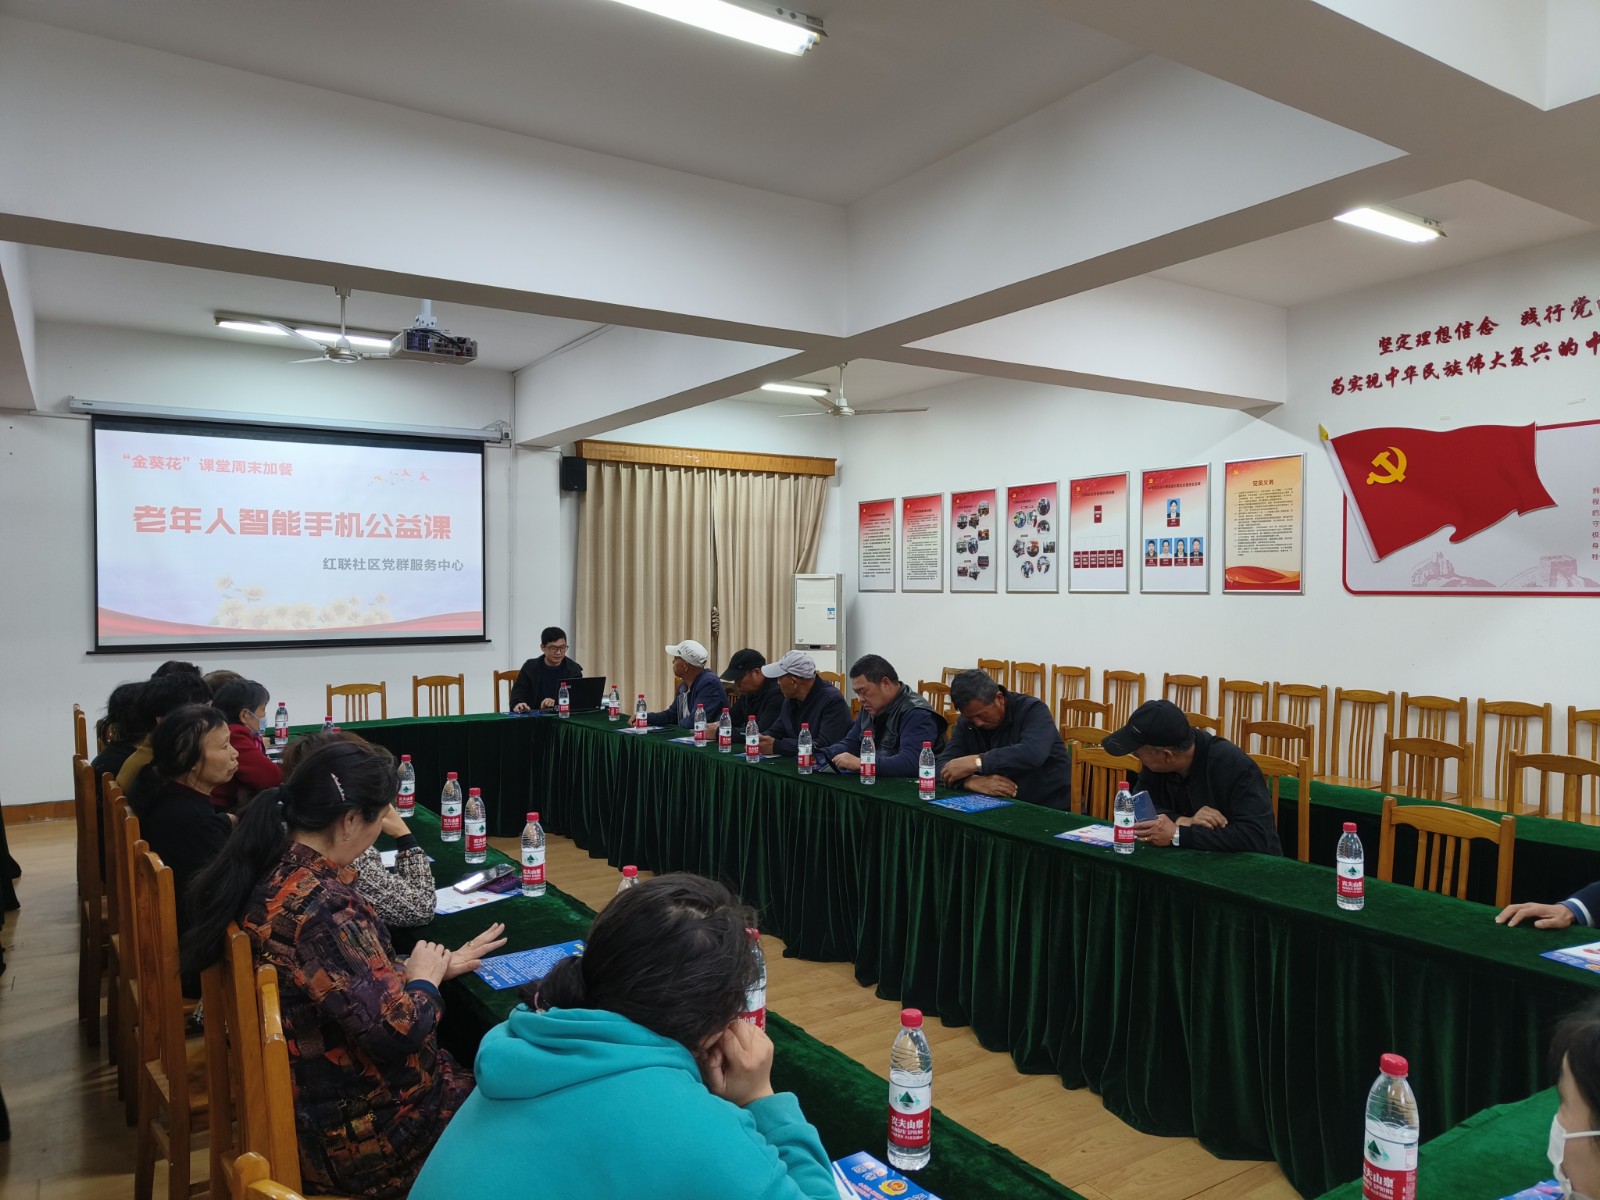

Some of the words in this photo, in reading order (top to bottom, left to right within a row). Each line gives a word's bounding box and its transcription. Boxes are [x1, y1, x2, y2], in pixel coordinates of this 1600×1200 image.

[1378, 315, 1499, 356] 坚定理想信念
[1520, 295, 1600, 327] 践行党
[132, 505, 452, 540] 老年人智能手机公益课
[323, 557, 464, 572] 红联社区党群服务中心
[891, 1116, 924, 1129] 农夫山泉
